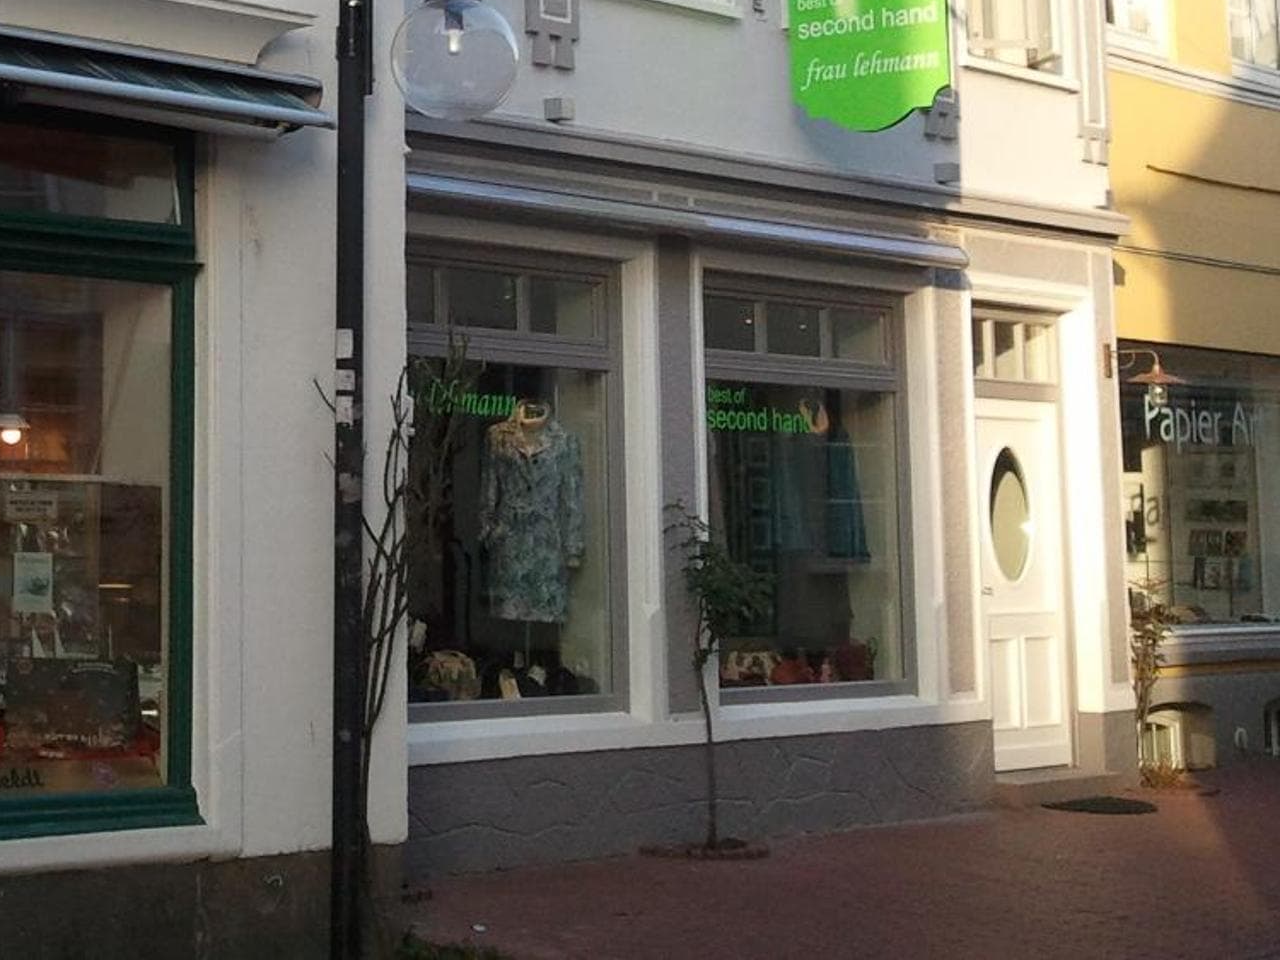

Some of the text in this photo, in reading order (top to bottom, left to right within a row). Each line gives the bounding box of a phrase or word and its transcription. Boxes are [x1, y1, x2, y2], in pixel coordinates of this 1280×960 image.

[797, 1, 939, 40] second hand
[800, 49, 941, 92] frau lehmann
[707, 385, 748, 404] best of
[707, 406, 767, 432] second
[1144, 393, 1222, 455] Papier
